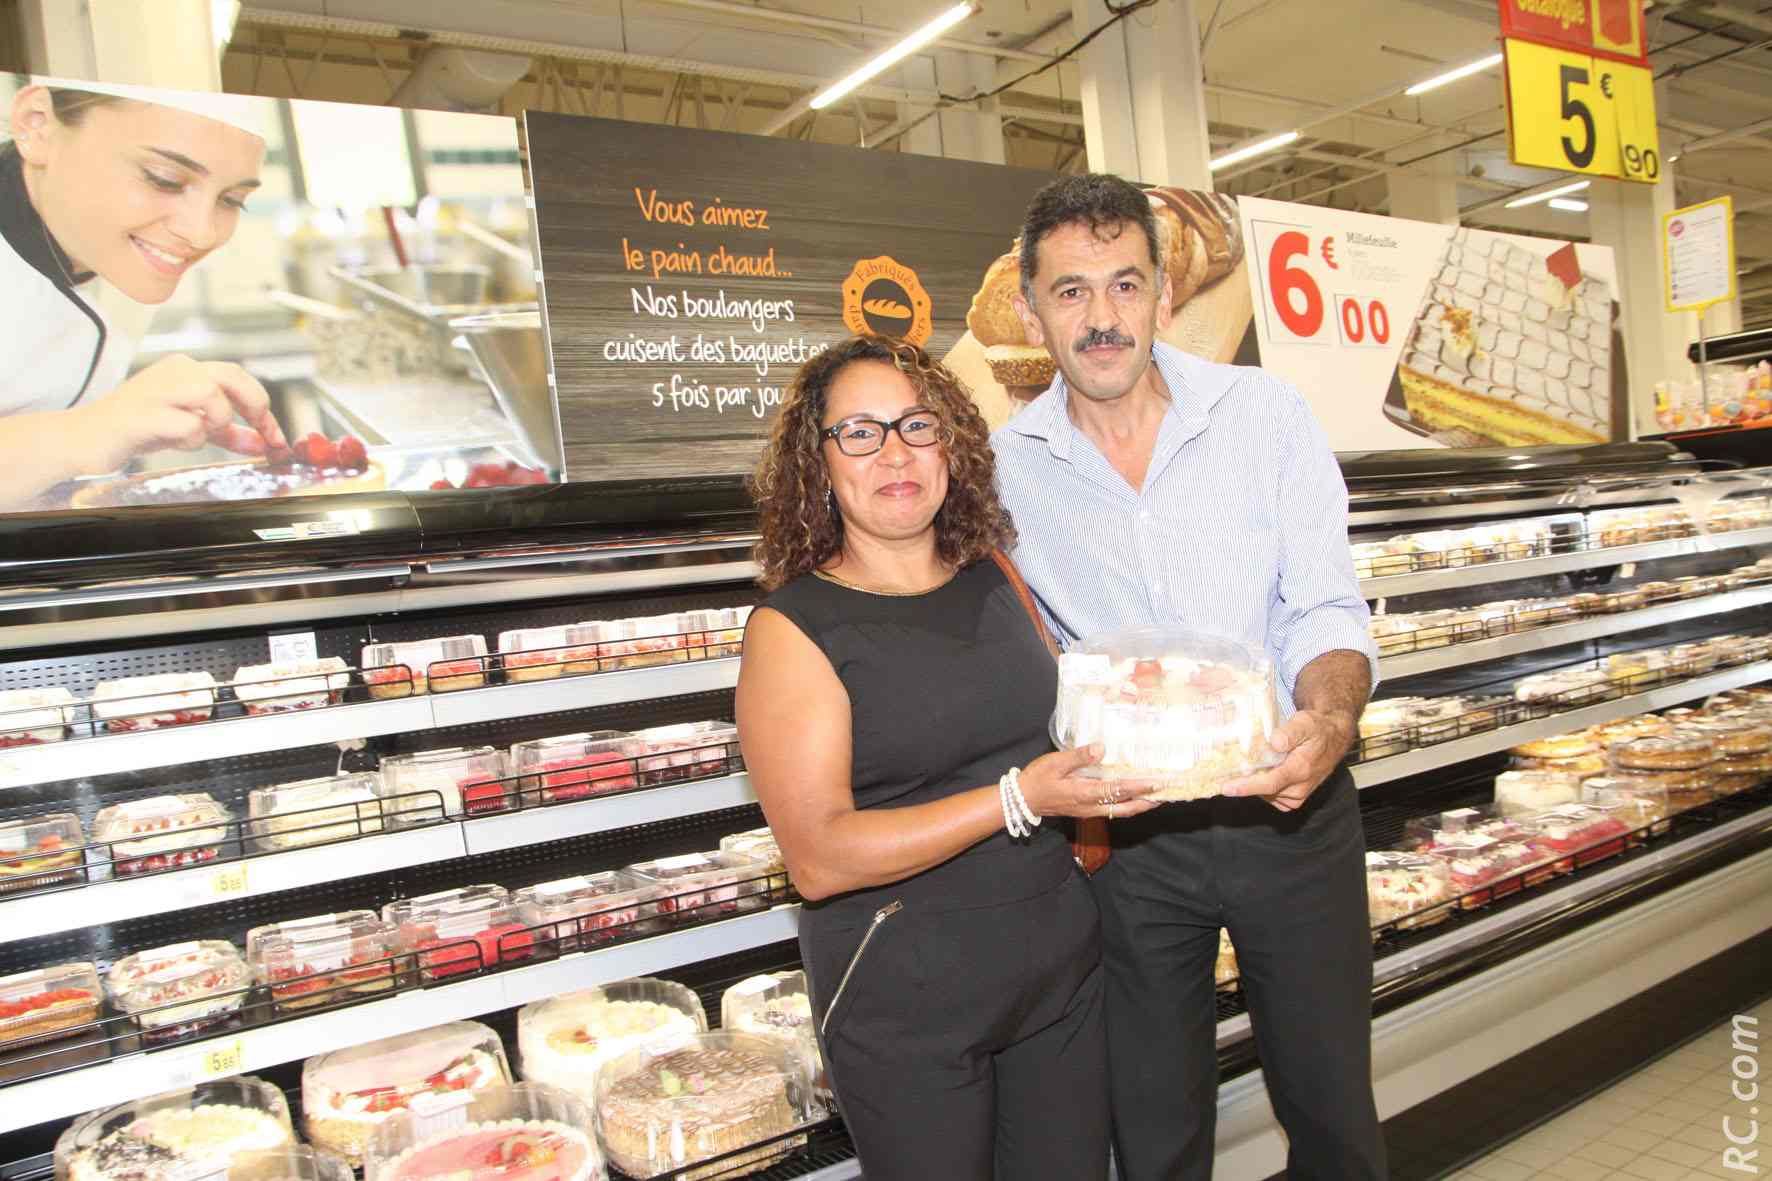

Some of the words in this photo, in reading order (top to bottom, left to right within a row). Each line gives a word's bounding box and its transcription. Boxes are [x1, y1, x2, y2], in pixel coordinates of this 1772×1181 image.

[1625, 144, 1658, 178] 90
[634, 187, 695, 226] Vous
[702, 196, 769, 230] aimez
[622, 237, 645, 270] le
[651, 242, 702, 280] pain
[708, 245, 792, 277] chaud...
[631, 286, 677, 318] Nos
[683, 289, 794, 333] boulangers
[1342, 298, 1389, 344] 00
[603, 333, 686, 363] cuisent
[691, 334, 725, 363] des
[652, 383, 664, 407] 5
[670, 374, 709, 411] fois
[716, 386, 751, 413] par
[752, 379, 785, 418] jou
